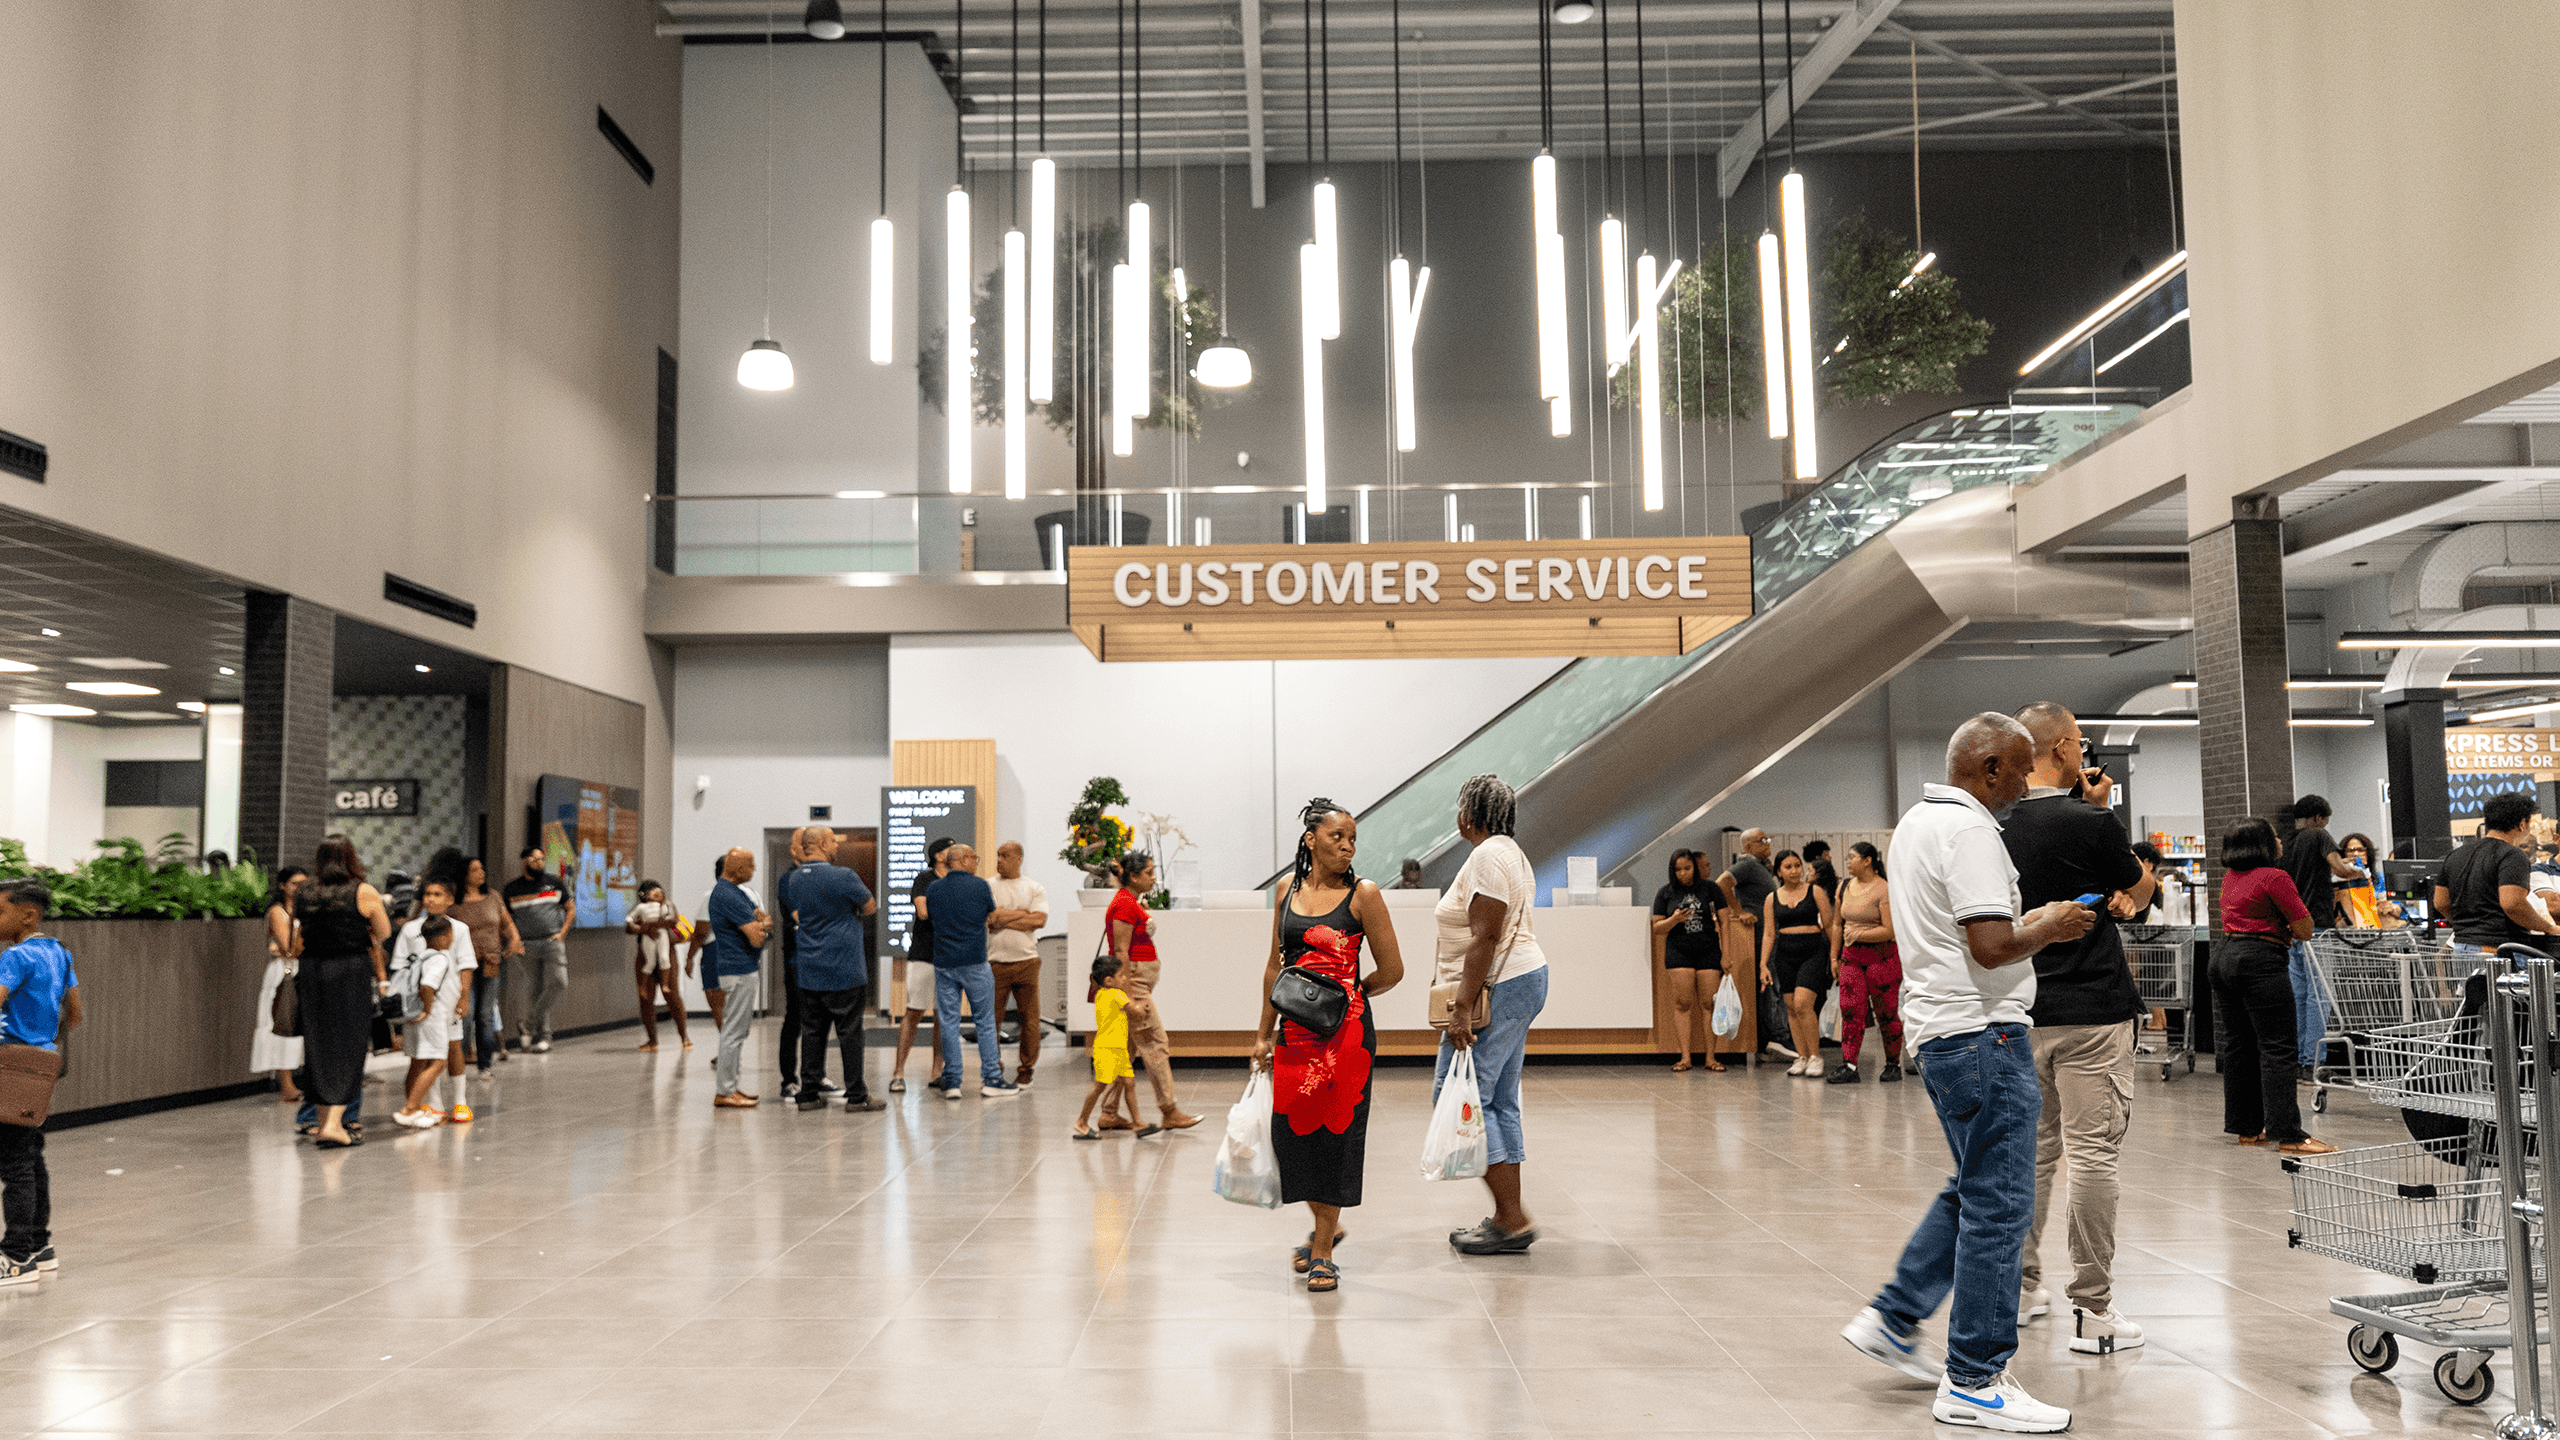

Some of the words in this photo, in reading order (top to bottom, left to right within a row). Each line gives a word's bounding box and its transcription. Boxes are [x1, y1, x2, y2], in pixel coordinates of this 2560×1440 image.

[1113, 559, 1440, 607] CUSTOMER
[1465, 555, 1708, 602] SERVICE
[2445, 733, 2539, 753] XPRESS
[2446, 755, 2468, 768] 10
[2473, 754, 2524, 768] ITEMS
[2529, 754, 2553, 767] OR
[334, 785, 399, 810] café
[888, 789, 965, 805] WELCOME
[888, 807, 913, 817] FIRST
[913, 807, 942, 817] FLOOR
[888, 826, 926, 835] COSMETICS
